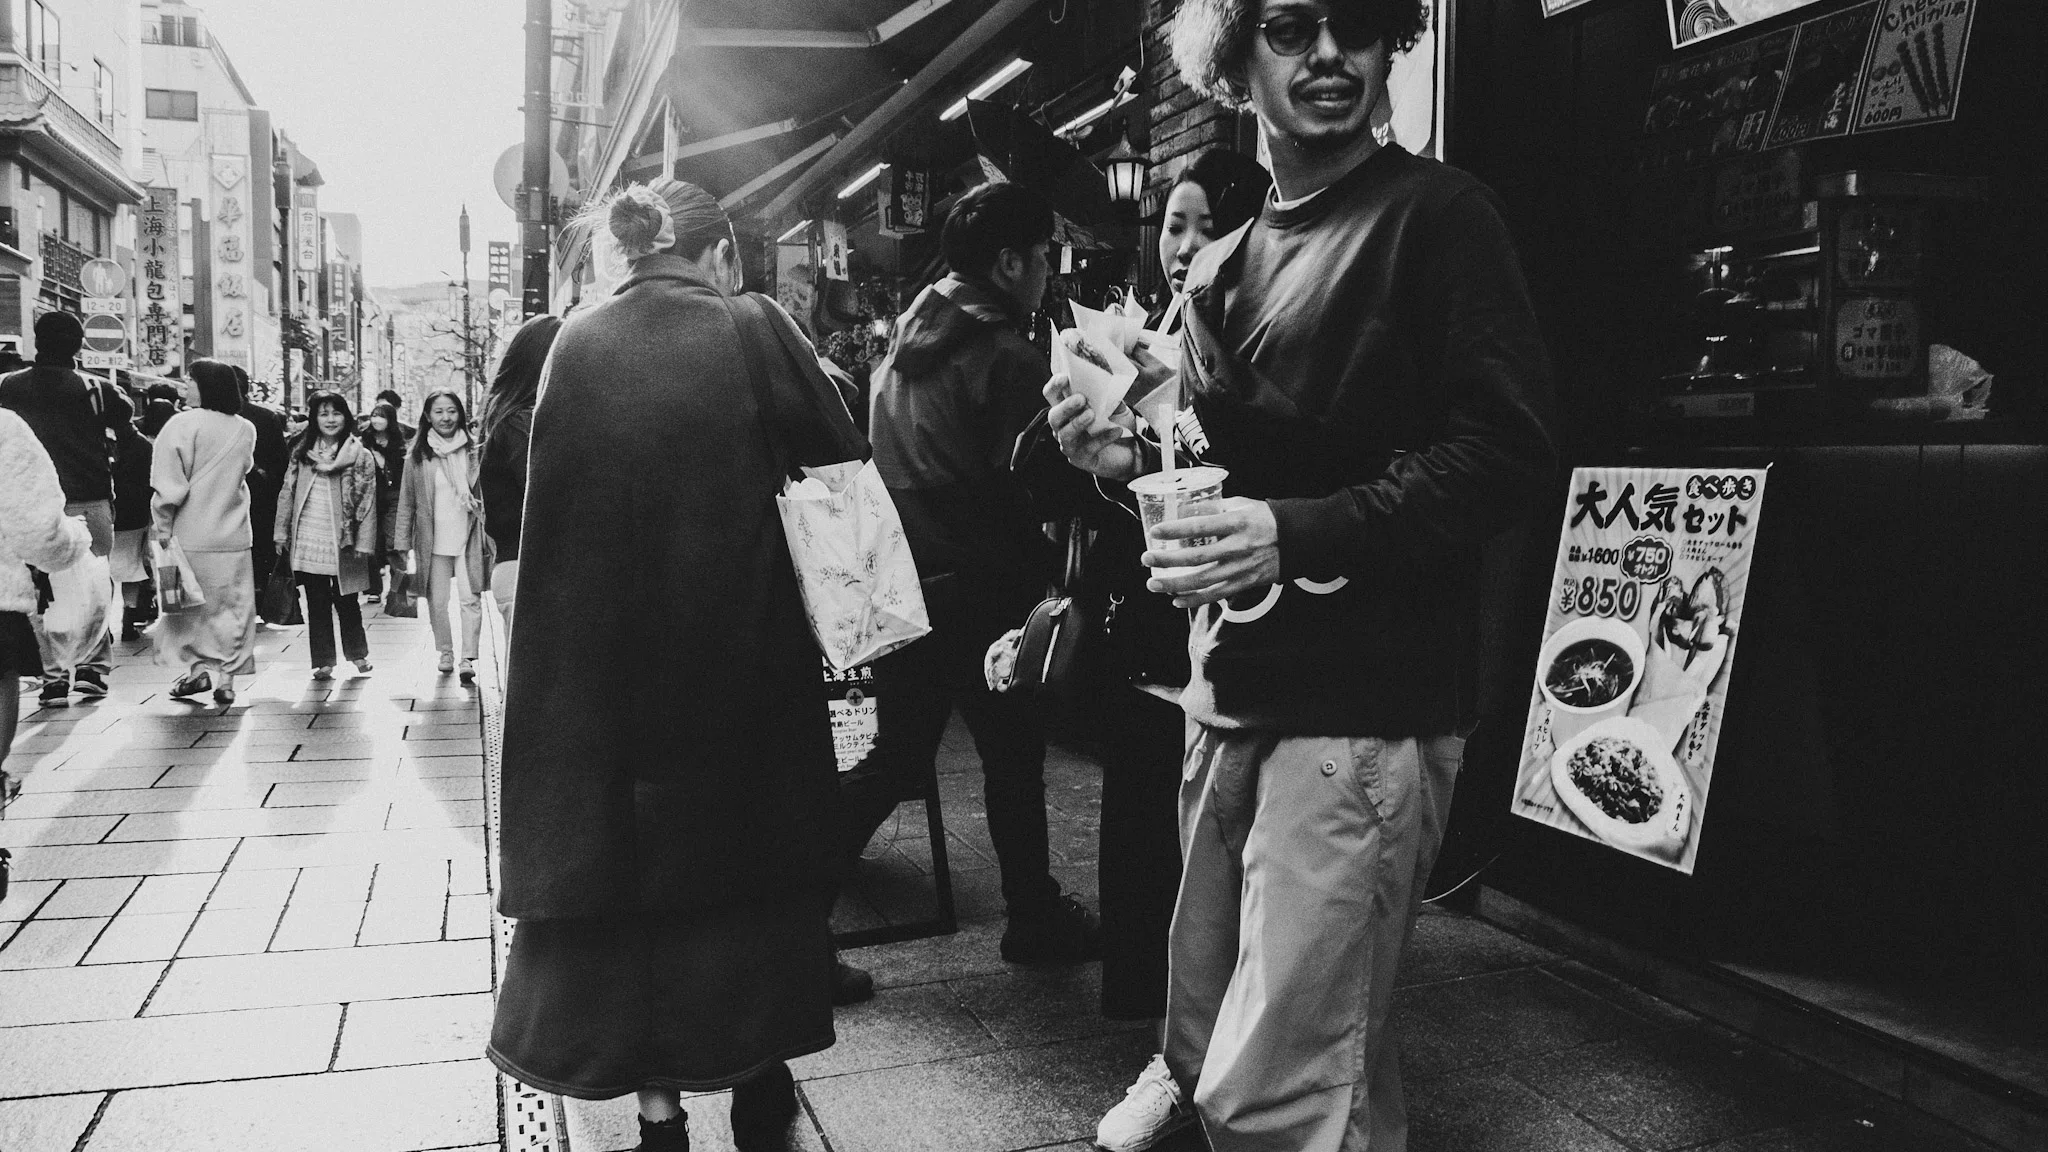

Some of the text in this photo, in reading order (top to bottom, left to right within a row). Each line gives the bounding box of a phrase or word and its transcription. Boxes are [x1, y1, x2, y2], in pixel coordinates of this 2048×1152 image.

[1864, 106, 1902, 124] 600円
[1687, 476, 1754, 499] 食べ歩き
[1570, 480, 1680, 533] 大人気
[1683, 503, 1747, 536] セット
[1581, 547, 1620, 565] ¥1600
[1627, 546, 1666, 564] ¥750
[1560, 576, 1640, 619] ¥850
[1532, 725, 1542, 750] スープ
[1542, 709, 1551, 742] フカヒレ
[1672, 792, 1685, 832] 大肉まん
